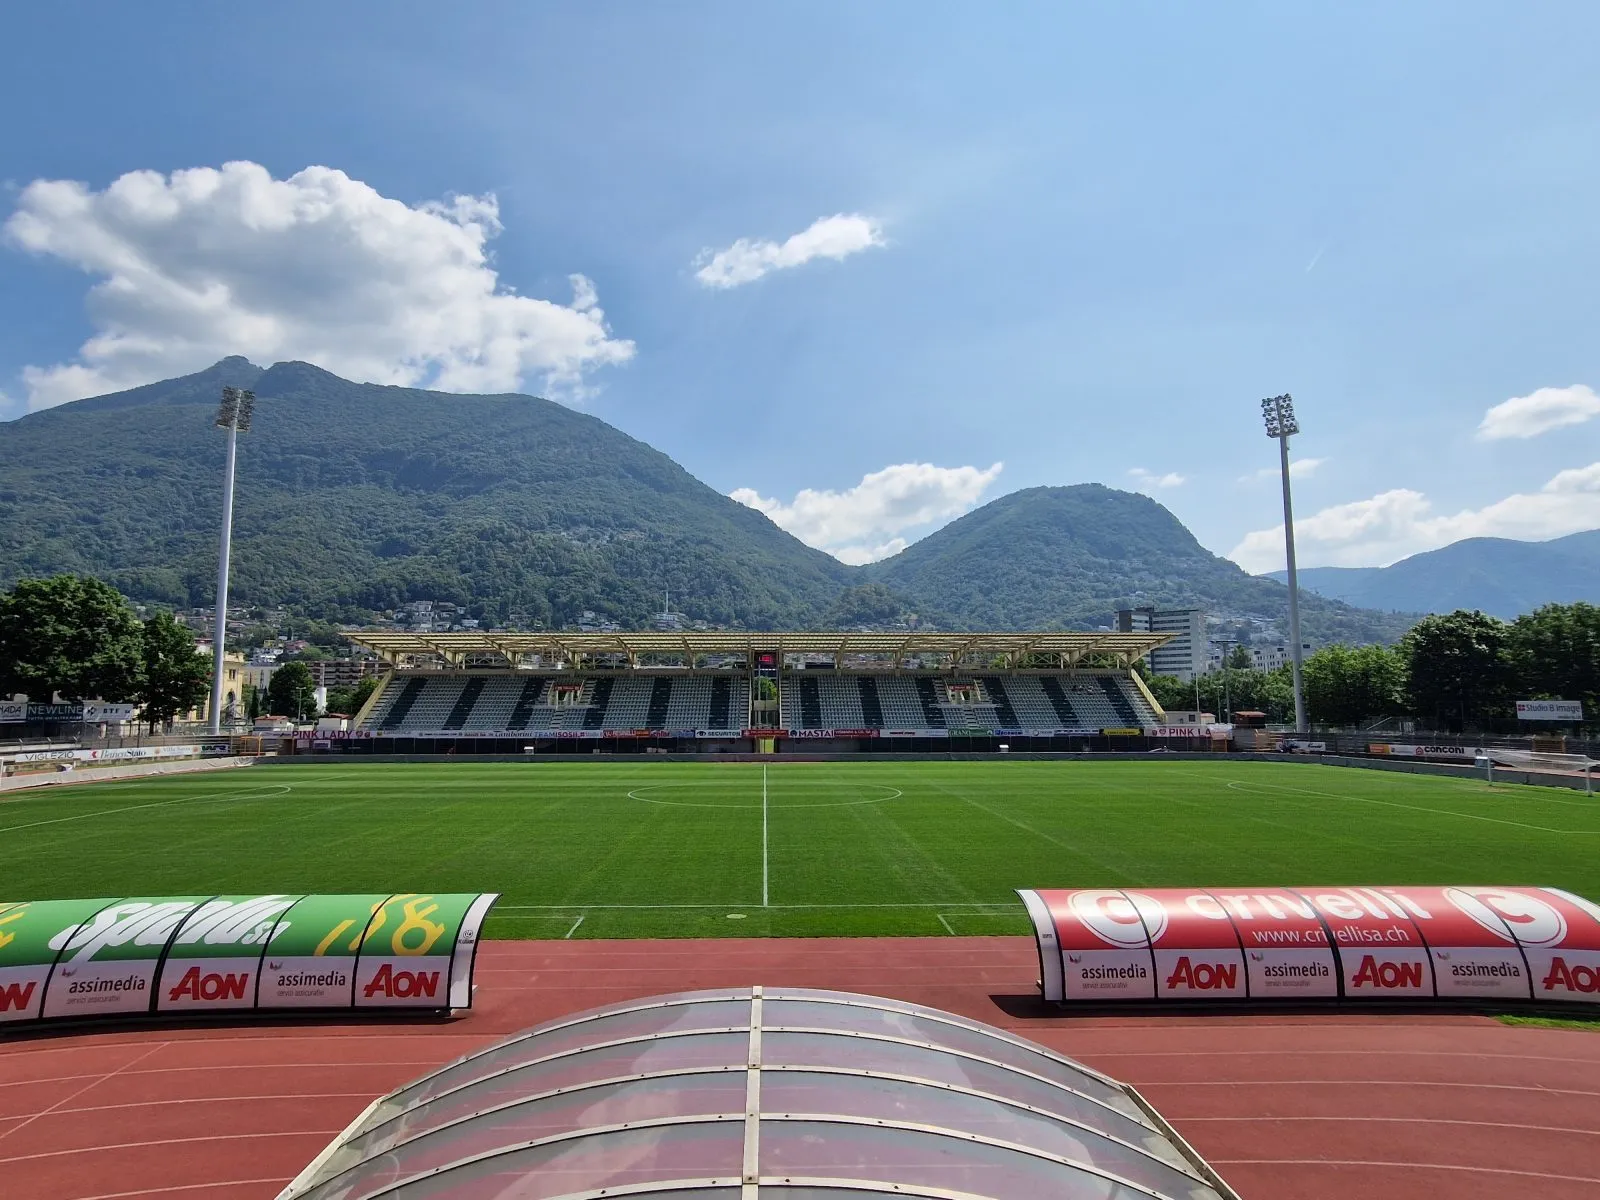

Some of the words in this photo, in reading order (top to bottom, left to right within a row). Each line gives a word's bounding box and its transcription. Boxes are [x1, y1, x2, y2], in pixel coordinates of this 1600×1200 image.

[28, 705, 83, 714] NEWLINE
[1527, 703, 1548, 712] Studio
[1557, 703, 1580, 714] Image
[292, 731, 318, 740] PINK
[323, 731, 353, 740] LADY
[1169, 728, 1194, 737] PINK
[1425, 746, 1465, 754] conconi
[1185, 888, 1432, 920] crivelli
[1082, 963, 1147, 979] assimedia
[1264, 962, 1329, 977] assimedia
[1452, 962, 1520, 977] assimedia
[1542, 956, 1600, 993] AO
[69, 975, 146, 994] assimedia
[278, 970, 346, 987] assimedia
